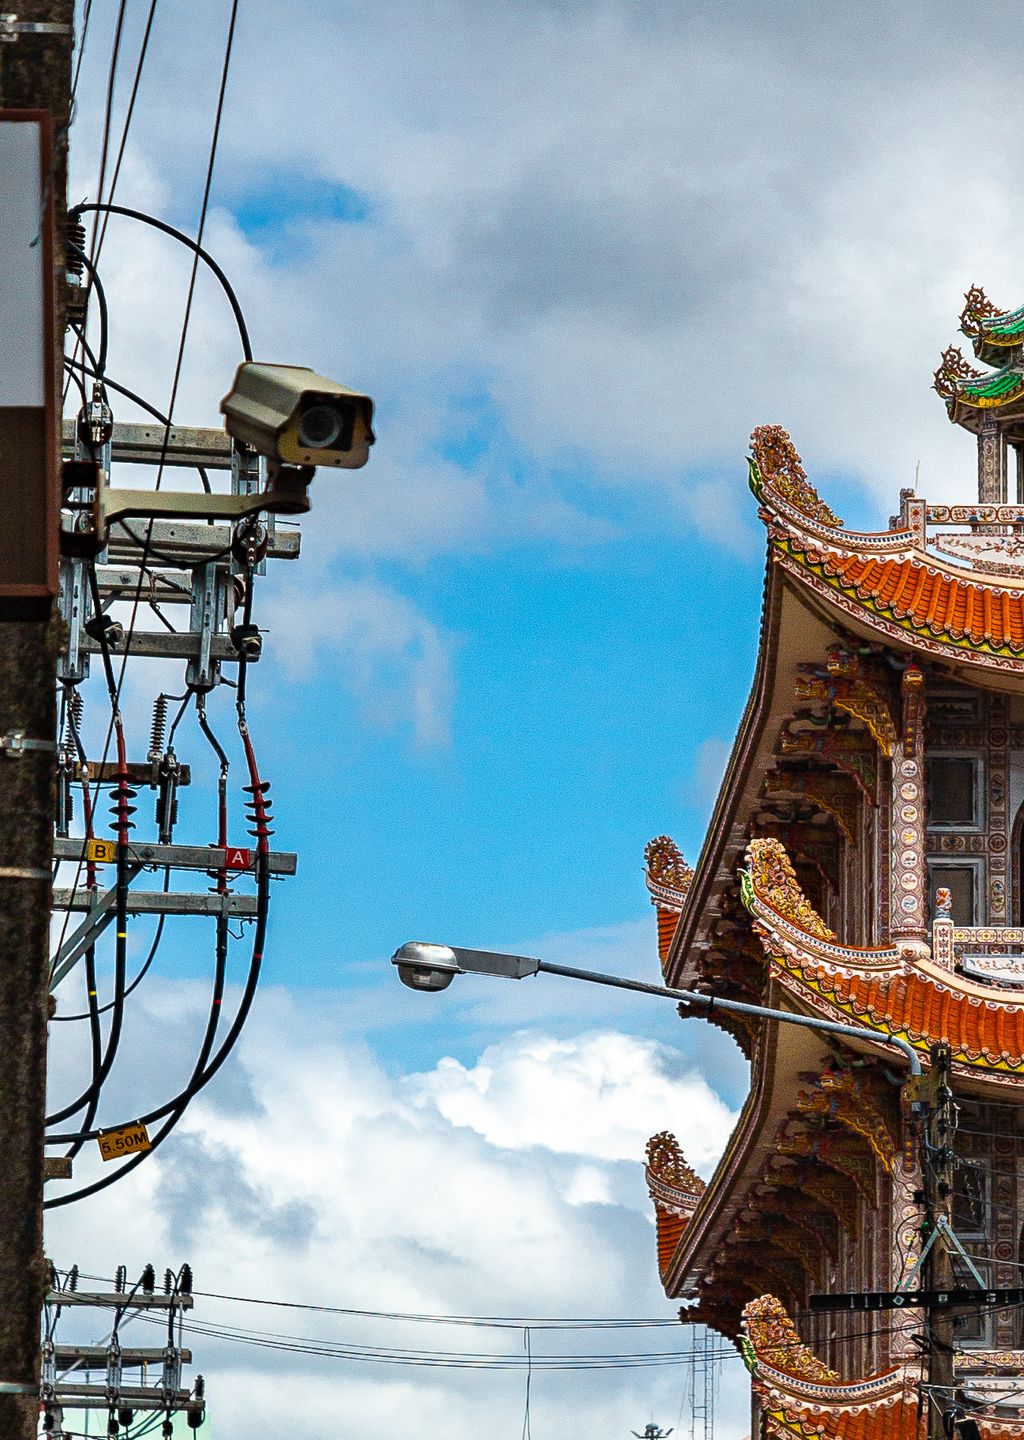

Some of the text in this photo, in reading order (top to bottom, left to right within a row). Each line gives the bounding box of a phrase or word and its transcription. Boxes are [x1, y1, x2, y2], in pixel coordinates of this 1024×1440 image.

[93, 845, 106, 858] B
[231, 851, 245, 864] A
[101, 1131, 148, 1154] 5.50M
